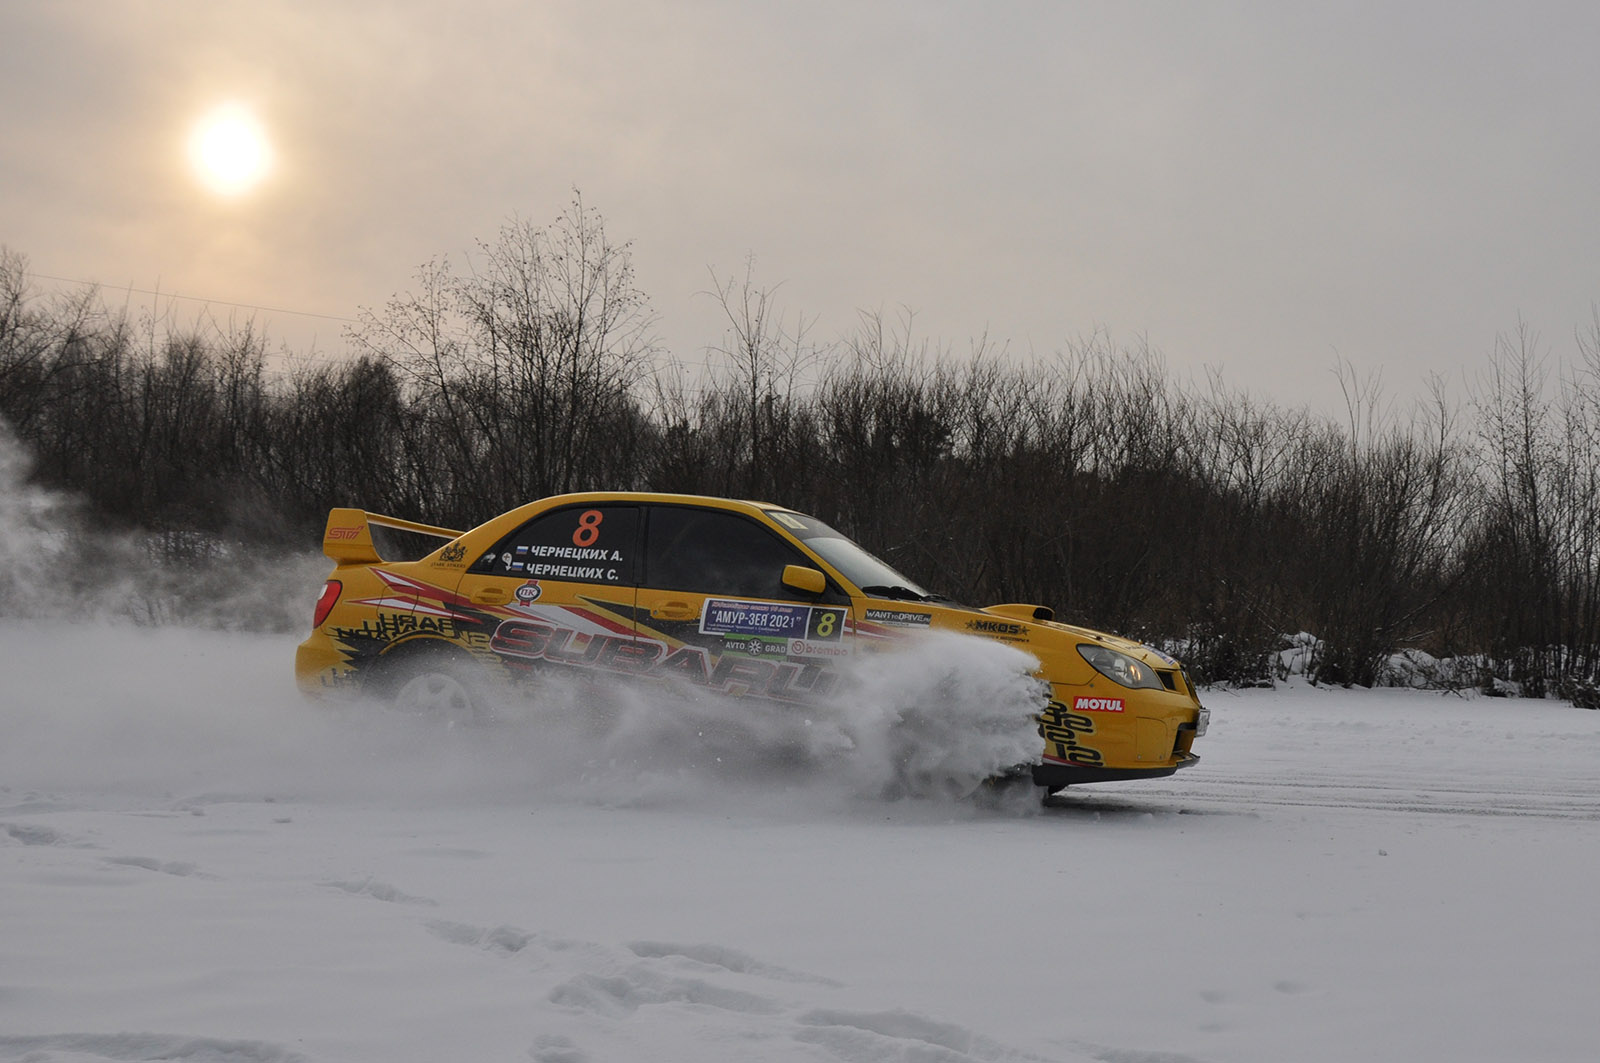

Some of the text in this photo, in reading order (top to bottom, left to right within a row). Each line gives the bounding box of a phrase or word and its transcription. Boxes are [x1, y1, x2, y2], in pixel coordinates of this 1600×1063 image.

[572, 509, 604, 547] 8
[531, 545, 624, 561] ЧЕРНЕЦКИХ А.
[526, 563, 619, 580] ЧЕРНЕЦКИХ С.
[816, 612, 837, 637] 8
[725, 641, 746, 650] AVTO
[765, 644, 786, 654] GRAD
[489, 617, 842, 702] SUBARU
[1074, 698, 1123, 712] MOTUL
